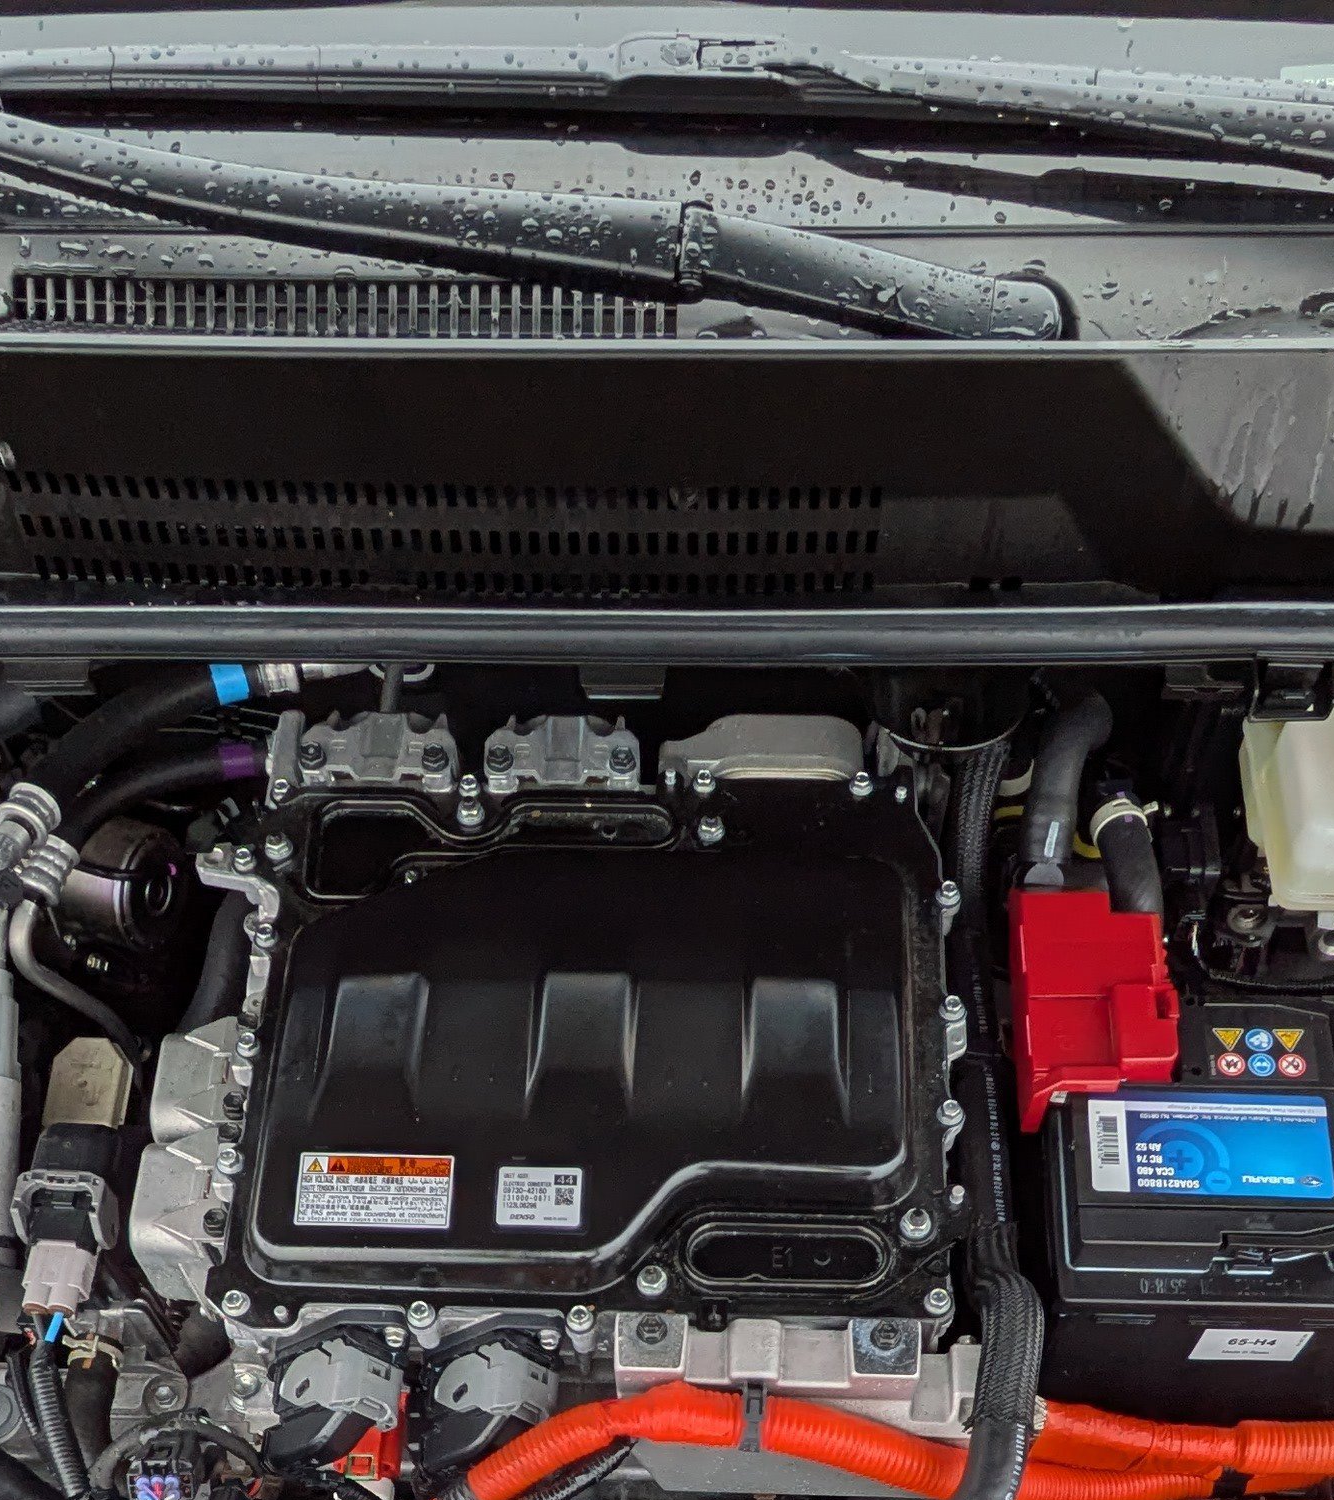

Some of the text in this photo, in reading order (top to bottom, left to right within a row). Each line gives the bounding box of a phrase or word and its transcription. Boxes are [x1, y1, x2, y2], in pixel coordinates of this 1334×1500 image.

[1149, 1143, 1162, 1152] Ah
[1149, 1155, 1163, 1164] RC
[1155, 1167, 1175, 1176] CCA
[557, 1175, 574, 1185] 44
[1242, 1175, 1295, 1185] SUBARU
[1228, 1338, 1277, 1346] 65-H4
[1013, 1434, 1026, 1462] WATER
